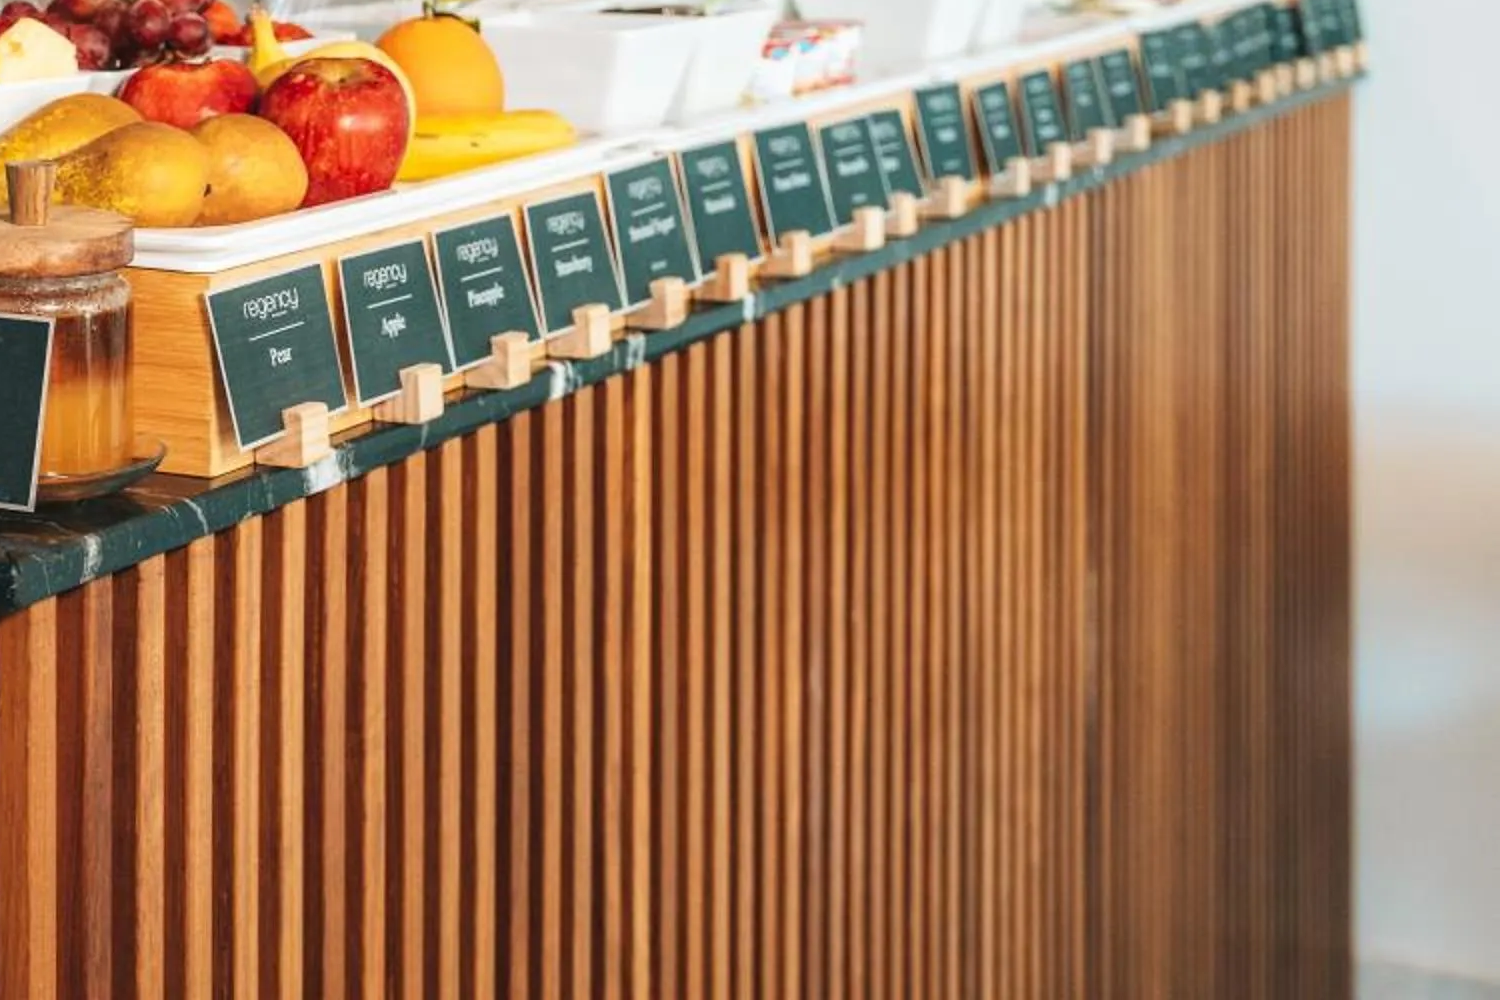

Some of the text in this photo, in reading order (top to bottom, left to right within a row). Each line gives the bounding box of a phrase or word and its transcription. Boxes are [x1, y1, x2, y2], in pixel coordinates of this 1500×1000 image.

[363, 263, 407, 291] regency
[243, 286, 299, 319] regency
[381, 312, 407, 338] Apple
[269, 347, 293, 367] Pear
